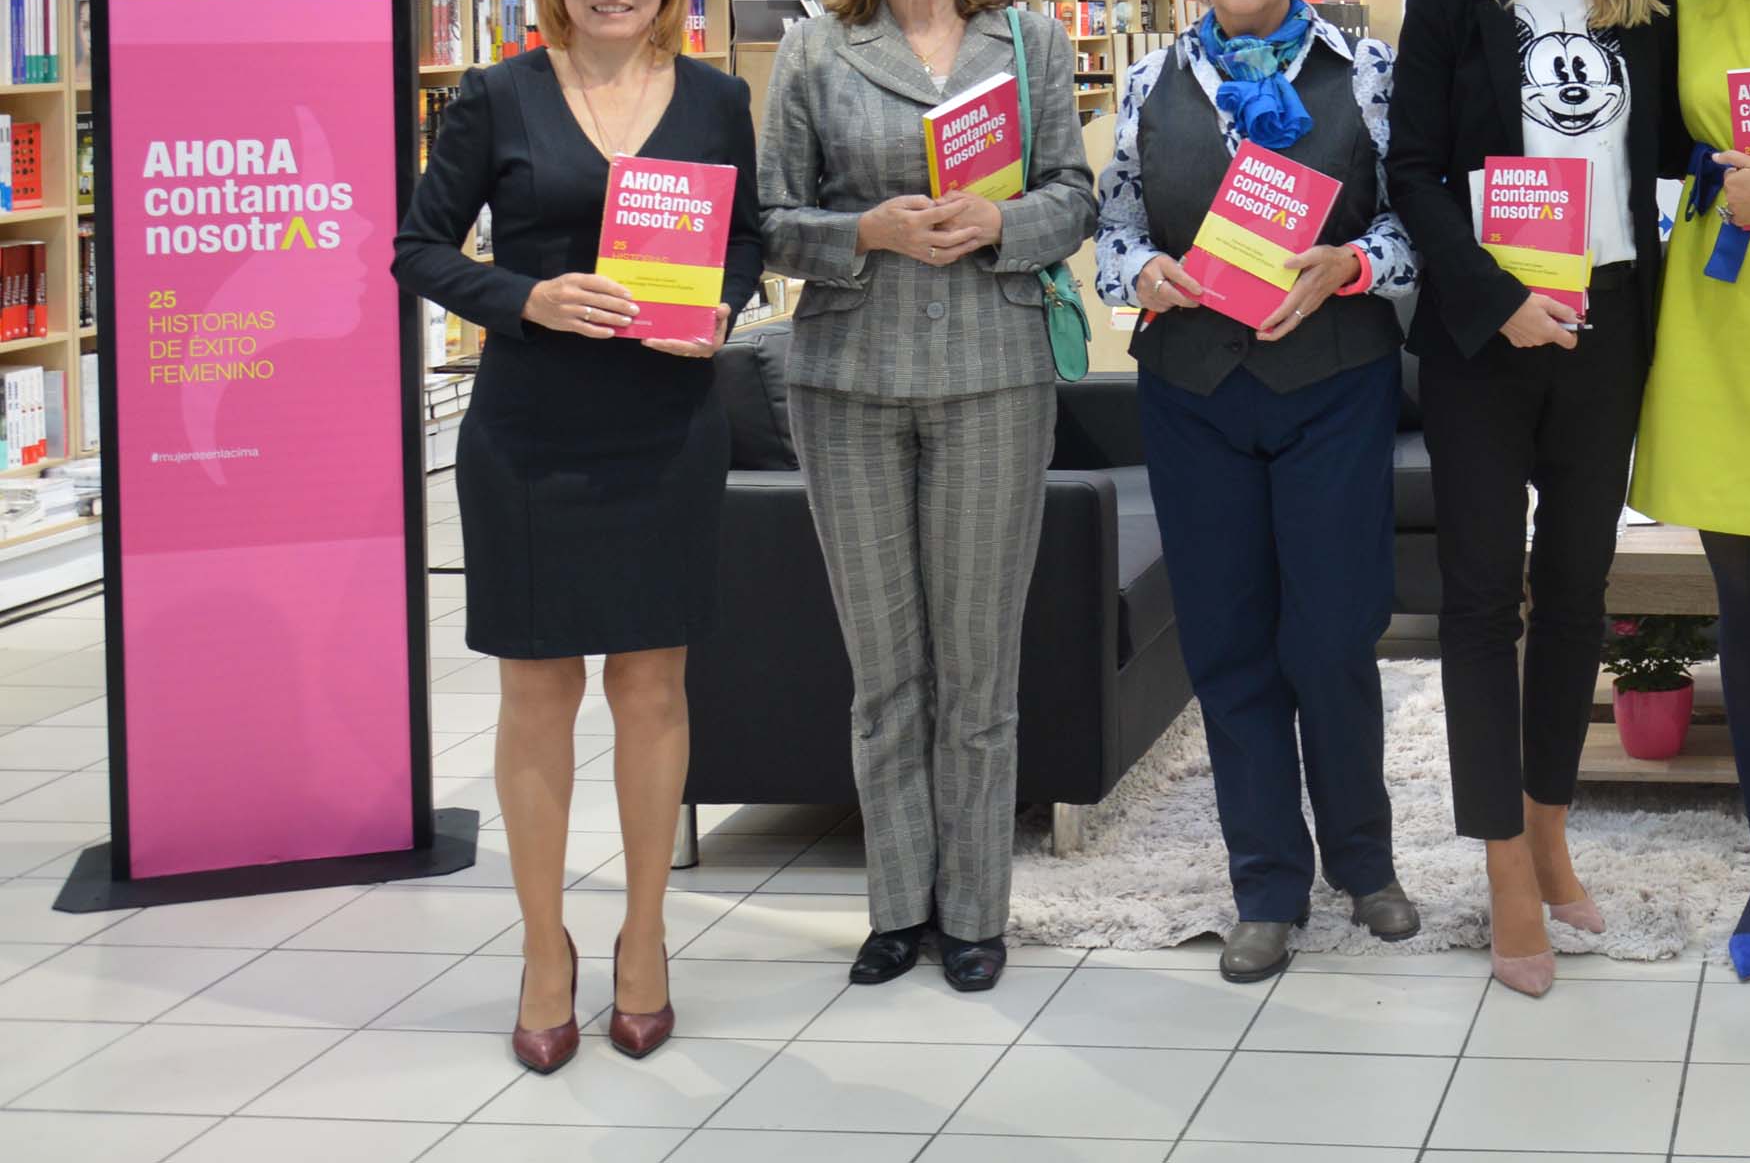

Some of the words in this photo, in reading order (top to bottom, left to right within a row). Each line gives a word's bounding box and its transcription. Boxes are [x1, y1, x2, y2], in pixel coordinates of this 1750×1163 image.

[942, 104, 990, 141] AHORA
[944, 113, 1006, 155] contamos
[142, 138, 298, 177] AHORA
[620, 170, 690, 195] AHORA
[1239, 156, 1296, 193] AHORA
[1491, 169, 1548, 186] AHORA
[144, 179, 353, 216] contamos
[618, 192, 713, 215] contamos
[1233, 174, 1309, 217] contamos
[1491, 187, 1569, 203] contamos
[149, 290, 177, 309] 25
[149, 310, 276, 334] HISTORIAS
[150, 339, 182, 359] DE
[189, 335, 257, 357] ÉXITO
[151, 360, 275, 384] FEMENINO
